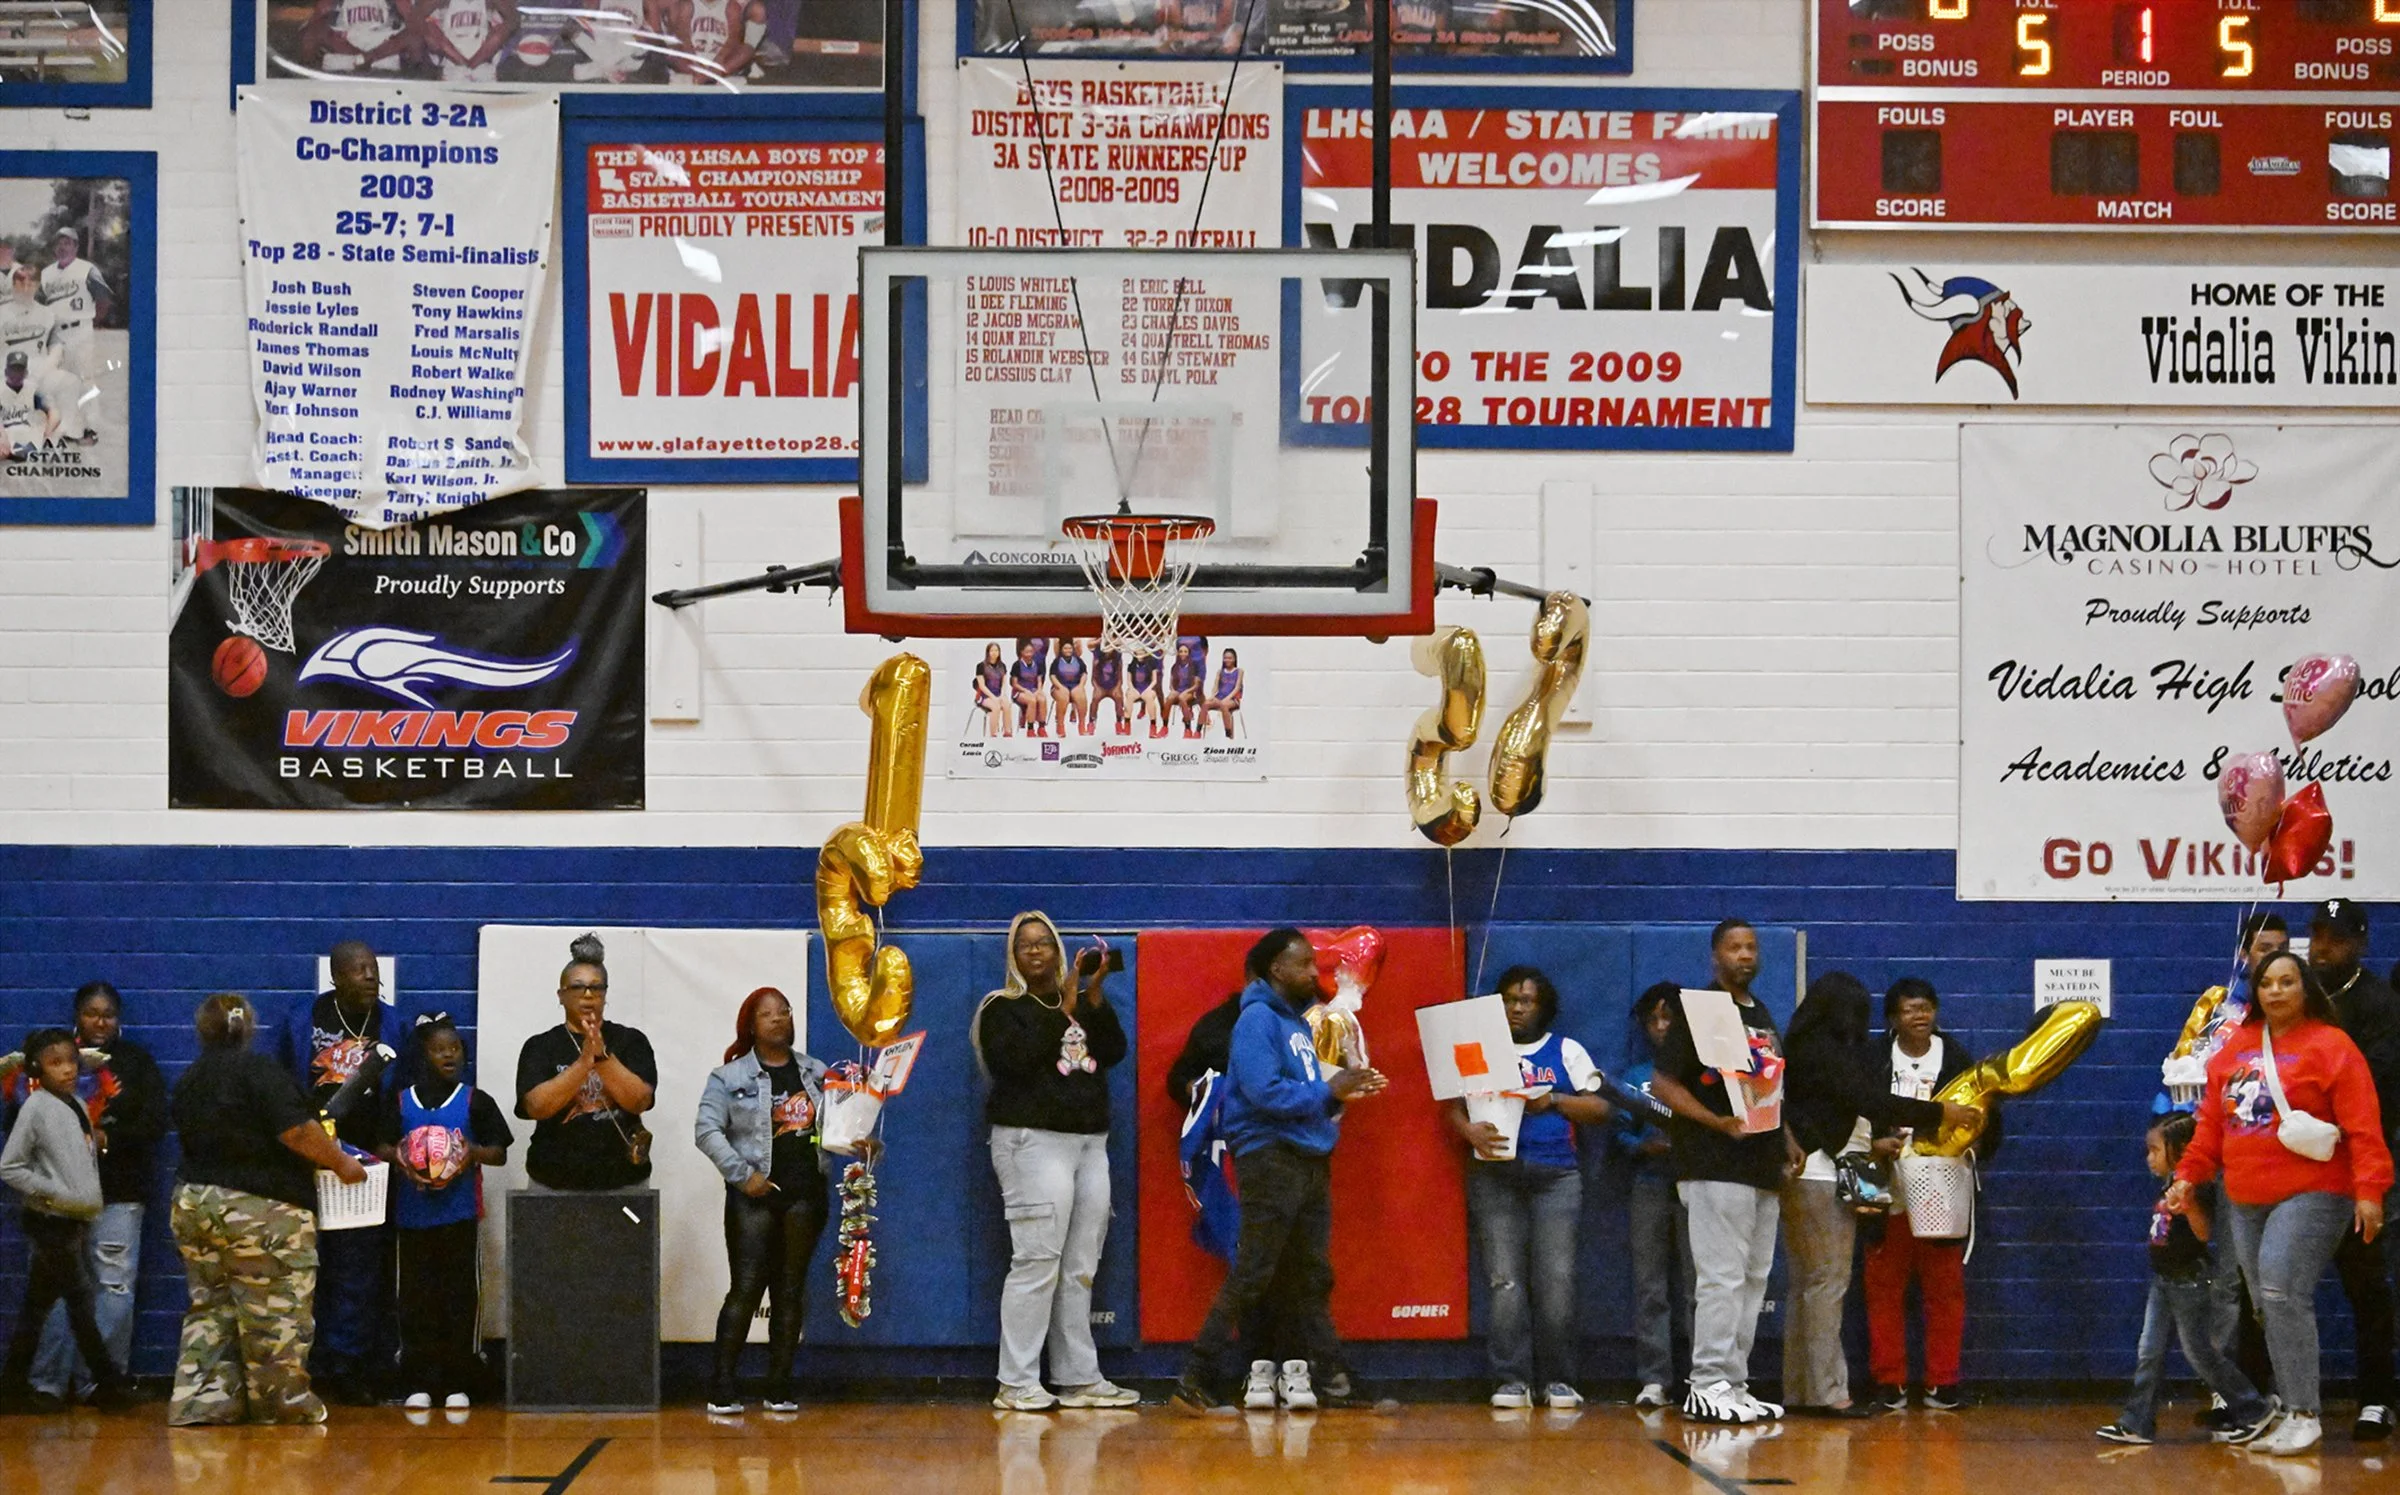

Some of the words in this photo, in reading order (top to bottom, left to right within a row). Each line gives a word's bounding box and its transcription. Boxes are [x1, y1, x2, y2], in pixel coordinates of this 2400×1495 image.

[1878, 34, 1935, 51] POSS
[2141, 7, 2152, 63] 1
[2017, 14, 2051, 75] 5
[2219, 15, 2253, 76] 5
[2336, 38, 2393, 55] POSS
[1903, 59, 1978, 77] BONUS
[2294, 63, 2369, 80] BONUS
[2101, 70, 2170, 86] PERIOD
[1081, 80, 1226, 107] BASKETBALL
[310, 100, 412, 126] District
[422, 102, 488, 127] 3-2A
[1878, 108, 1945, 125] FOULS
[2054, 109, 2134, 128] PLAYER
[2169, 110, 2223, 128] FOUL
[2325, 111, 2392, 129] FOULS
[972, 110, 1073, 138] DISTRICT
[1082, 113, 1131, 139] 3-3A
[1140, 113, 1270, 140] CHAMPIONS
[1505, 110, 1635, 140] STATE
[1653, 111, 1771, 141] FARM
[296, 136, 499, 168] Co-Champions
[595, 150, 638, 166] THE
[690, 149, 762, 166] LHSAA
[768, 148, 822, 166] BOYS
[828, 147, 870, 165] TOP
[994, 143, 1020, 169] 3A
[1028, 144, 1099, 171] STATE
[1107, 145, 1247, 172] RUNNERS-UP
[1418, 152, 1662, 186] WELCOMES
[360, 174, 434, 200] 2003
[698, 171, 863, 187] CHAMPIONSHIP
[1059, 176, 1180, 204] 2008-2009
[602, 192, 736, 209] BASKETBALL
[742, 191, 886, 208] TOURNAMENT
[1876, 199, 1946, 217] SCORE
[2097, 201, 2172, 219] MATCH
[2326, 203, 2397, 220] SCORE
[336, 210, 407, 237] 25-7;
[417, 213, 455, 237] 7-1
[640, 215, 736, 237] PROUDLY
[746, 214, 855, 236] PRESENTS
[968, 227, 1009, 247] 10-0
[1015, 228, 1103, 247] DISTRICT
[1124, 230, 1168, 248] 32-2
[1175, 230, 1260, 248] OVERALL
[249, 240, 285, 264] Top
[292, 242, 321, 261] 28
[342, 243, 396, 262] State
[1304, 223, 1774, 312] VDALIA
[272, 280, 306, 295] Josh
[312, 281, 352, 296] Bush
[412, 282, 466, 298] Steven
[471, 284, 525, 302] Cooper
[979, 276, 1015, 292] LOUIS
[1122, 278, 1135, 294] 21
[1139, 279, 1169, 294] ERIC
[1173, 279, 1206, 295] BELL
[967, 295, 976, 310] 11
[980, 295, 1005, 310] DEE
[1009, 295, 1068, 311] FLEMING
[2191, 284, 2276, 306] HOME
[2286, 284, 2325, 307] OF
[2334, 285, 2385, 307] THE
[265, 300, 312, 315] Jessie
[316, 302, 359, 319] Lyles
[412, 303, 452, 321] Tony
[456, 305, 523, 321] Hawkins
[1122, 297, 1138, 312] 22
[1194, 297, 1233, 313] DIXON
[248, 318, 314, 335] Roderick
[318, 322, 379, 337] Randall
[966, 313, 979, 328] 12
[983, 312, 1023, 328] JACOB
[1027, 313, 1082, 329] MCGRAW
[1121, 314, 1138, 330] 23
[1141, 315, 1198, 331] CHARLES
[1202, 316, 1240, 331] DAVIS
[414, 324, 449, 339] Fred
[454, 326, 520, 340] Marsalis
[966, 331, 978, 346] 14
[982, 331, 1015, 347] QUAN
[1018, 331, 1056, 347] RILEY
[1121, 332, 1137, 348] 24
[1218, 334, 1271, 349] THOMAS
[257, 338, 301, 356] James
[305, 342, 370, 357] Thomas
[411, 344, 454, 359] Louis
[609, 292, 859, 398] VIDALIA
[2142, 317, 2275, 384] Vidalia
[2296, 317, 2398, 385] Vikin
[965, 349, 979, 364] 15
[982, 349, 1044, 364] ROLANDIN
[1049, 350, 1110, 366] WEBSTER
[1121, 351, 1137, 366] 44
[1140, 351, 1173, 366] GARY
[1176, 352, 1237, 368] STEWART
[1470, 351, 1549, 382] THE
[1569, 352, 1682, 382] 2009
[262, 360, 304, 376] David
[307, 362, 362, 379] Wilson
[411, 364, 462, 379] Robert
[965, 366, 982, 382] 20
[985, 367, 1037, 382] CASSIUS
[1040, 368, 1073, 383] CLAY
[1186, 370, 1218, 385] POLK
[264, 380, 297, 400] Ajay
[301, 383, 358, 399] Warner
[389, 384, 447, 403] Rodney
[294, 402, 359, 418] Johnson
[415, 405, 442, 420] C.J.
[446, 405, 513, 421] Williams
[1482, 396, 1771, 429] TOURNAMENT
[266, 431, 305, 445] Head
[309, 432, 363, 445] Coach:
[27, 452, 83, 465] STATE
[309, 450, 363, 462] Coach:
[6, 465, 103, 478] CHAMPIONS
[384, 471, 417, 485] Karl
[344, 525, 420, 556] Smith
[2022, 523, 2223, 562] MAGNOLIA
[989, 552, 1078, 564] CONCORDIA
[2088, 558, 2199, 576] CASINO
[2228, 558, 2322, 577] HOTEL
[374, 574, 462, 599] Proudly
[468, 575, 566, 600] Supports
[2085, 598, 2187, 631] Proudly
[2197, 600, 2313, 631] Supports
[1988, 659, 2139, 701] Vidalia
[2149, 659, 2256, 714] High
[284, 709, 579, 748] VIKINGS
[1203, 746, 1226, 755] Zion
[1226, 746, 1244, 755] Hill
[279, 757, 574, 779] BASKETBALL
[2000, 745, 2187, 784] Academics
[2203, 746, 2230, 779] &
[2050, 968, 2078, 978] MUST
[2044, 982, 2087, 991] SEATED
[1391, 1304, 1450, 1318] GOPHER
